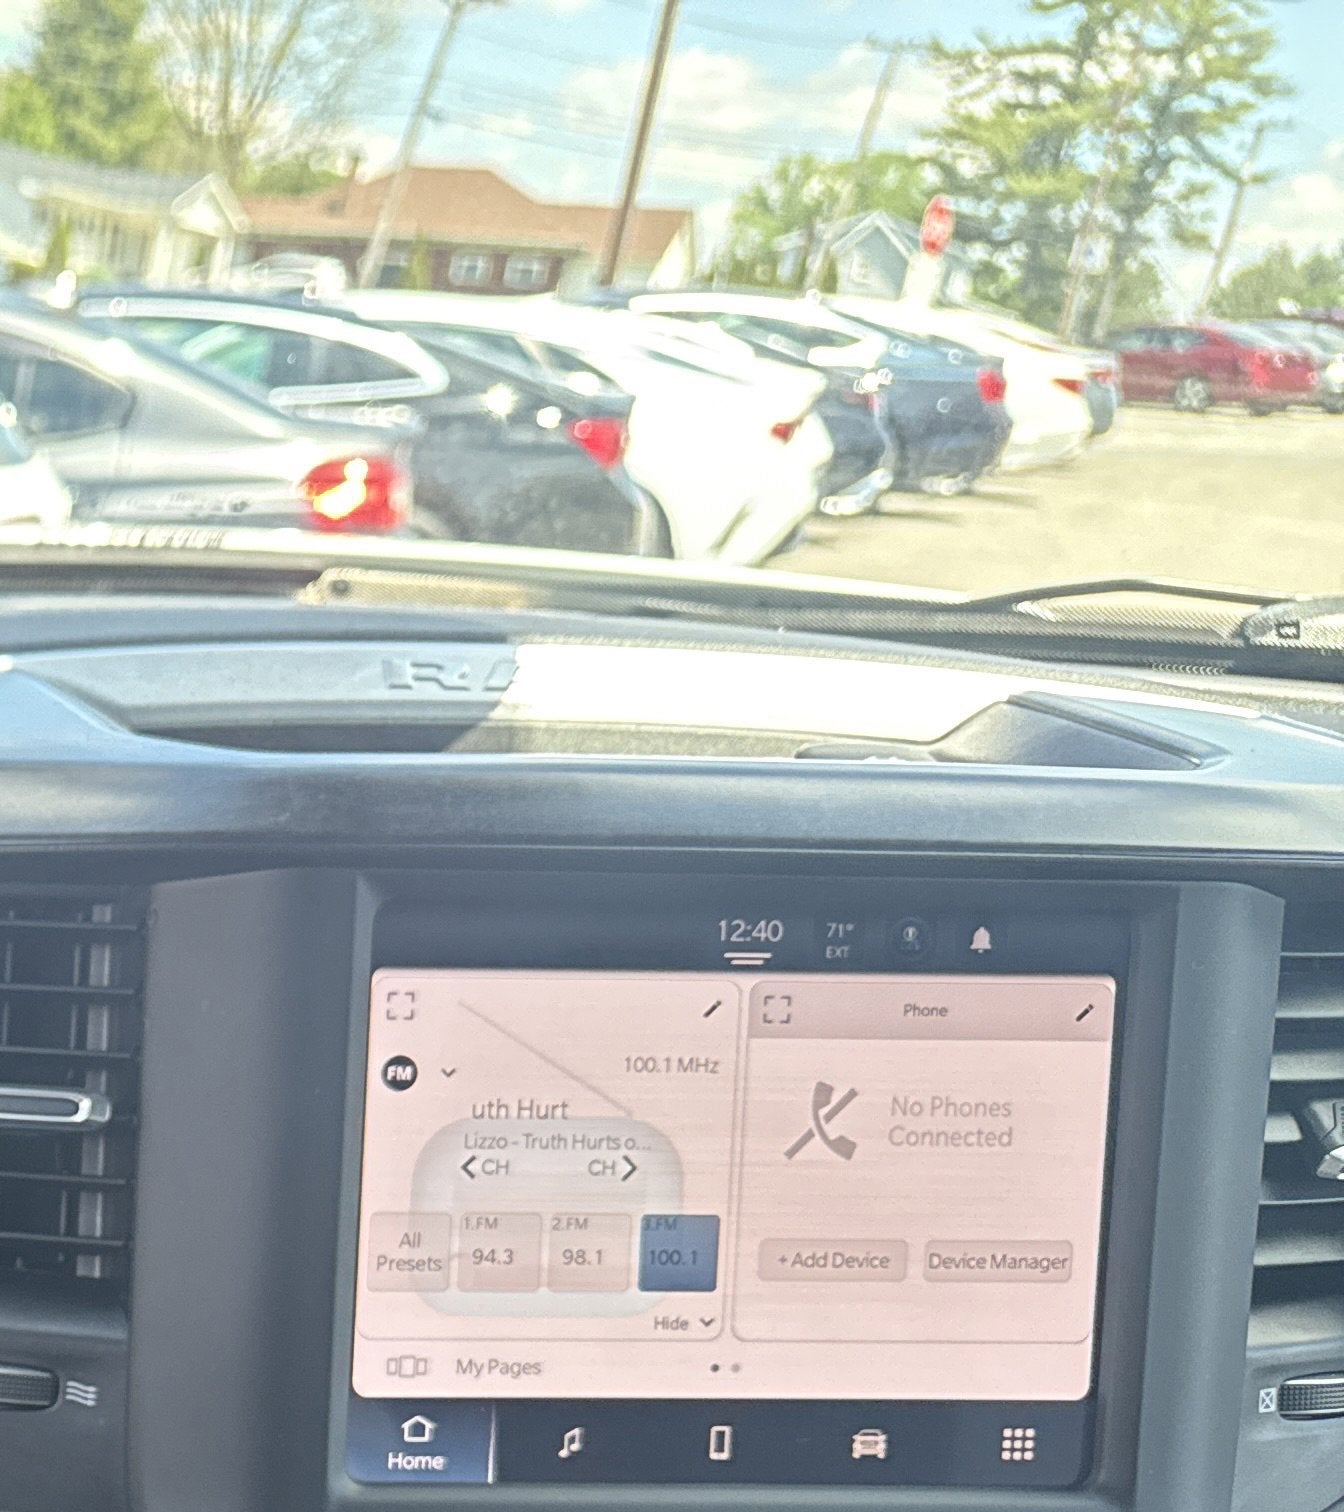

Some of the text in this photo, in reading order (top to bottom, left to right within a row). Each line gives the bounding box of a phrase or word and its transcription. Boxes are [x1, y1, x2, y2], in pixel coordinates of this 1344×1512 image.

[718, 919, 783, 943] 12:40
[826, 945, 850, 959] EXT
[903, 1003, 948, 1018] Phone
[386, 1063, 412, 1080] FM
[623, 1056, 719, 1074] 100.1 MHz
[471, 1098, 568, 1120] uth Hurt
[891, 1095, 1012, 1118] No Phones
[463, 1132, 508, 1150] Lizzo
[522, 1133, 568, 1150] Truth
[572, 1133, 621, 1150] Hurts
[888, 1126, 1013, 1149] Connected
[481, 1159, 510, 1175] CH
[588, 1160, 615, 1176] CH
[399, 1232, 421, 1247] All
[376, 1255, 442, 1272] Presets
[472, 1249, 513, 1265] 94.3
[562, 1249, 603, 1265] 98.1
[649, 1250, 698, 1265] 100.1
[791, 1252, 828, 1268] Add
[832, 1252, 890, 1269] Device
[928, 1252, 1069, 1273] Device Manager
[654, 1316, 689, 1331] Hide
[456, 1359, 541, 1377] My Pages
[388, 1453, 444, 1471] Home
